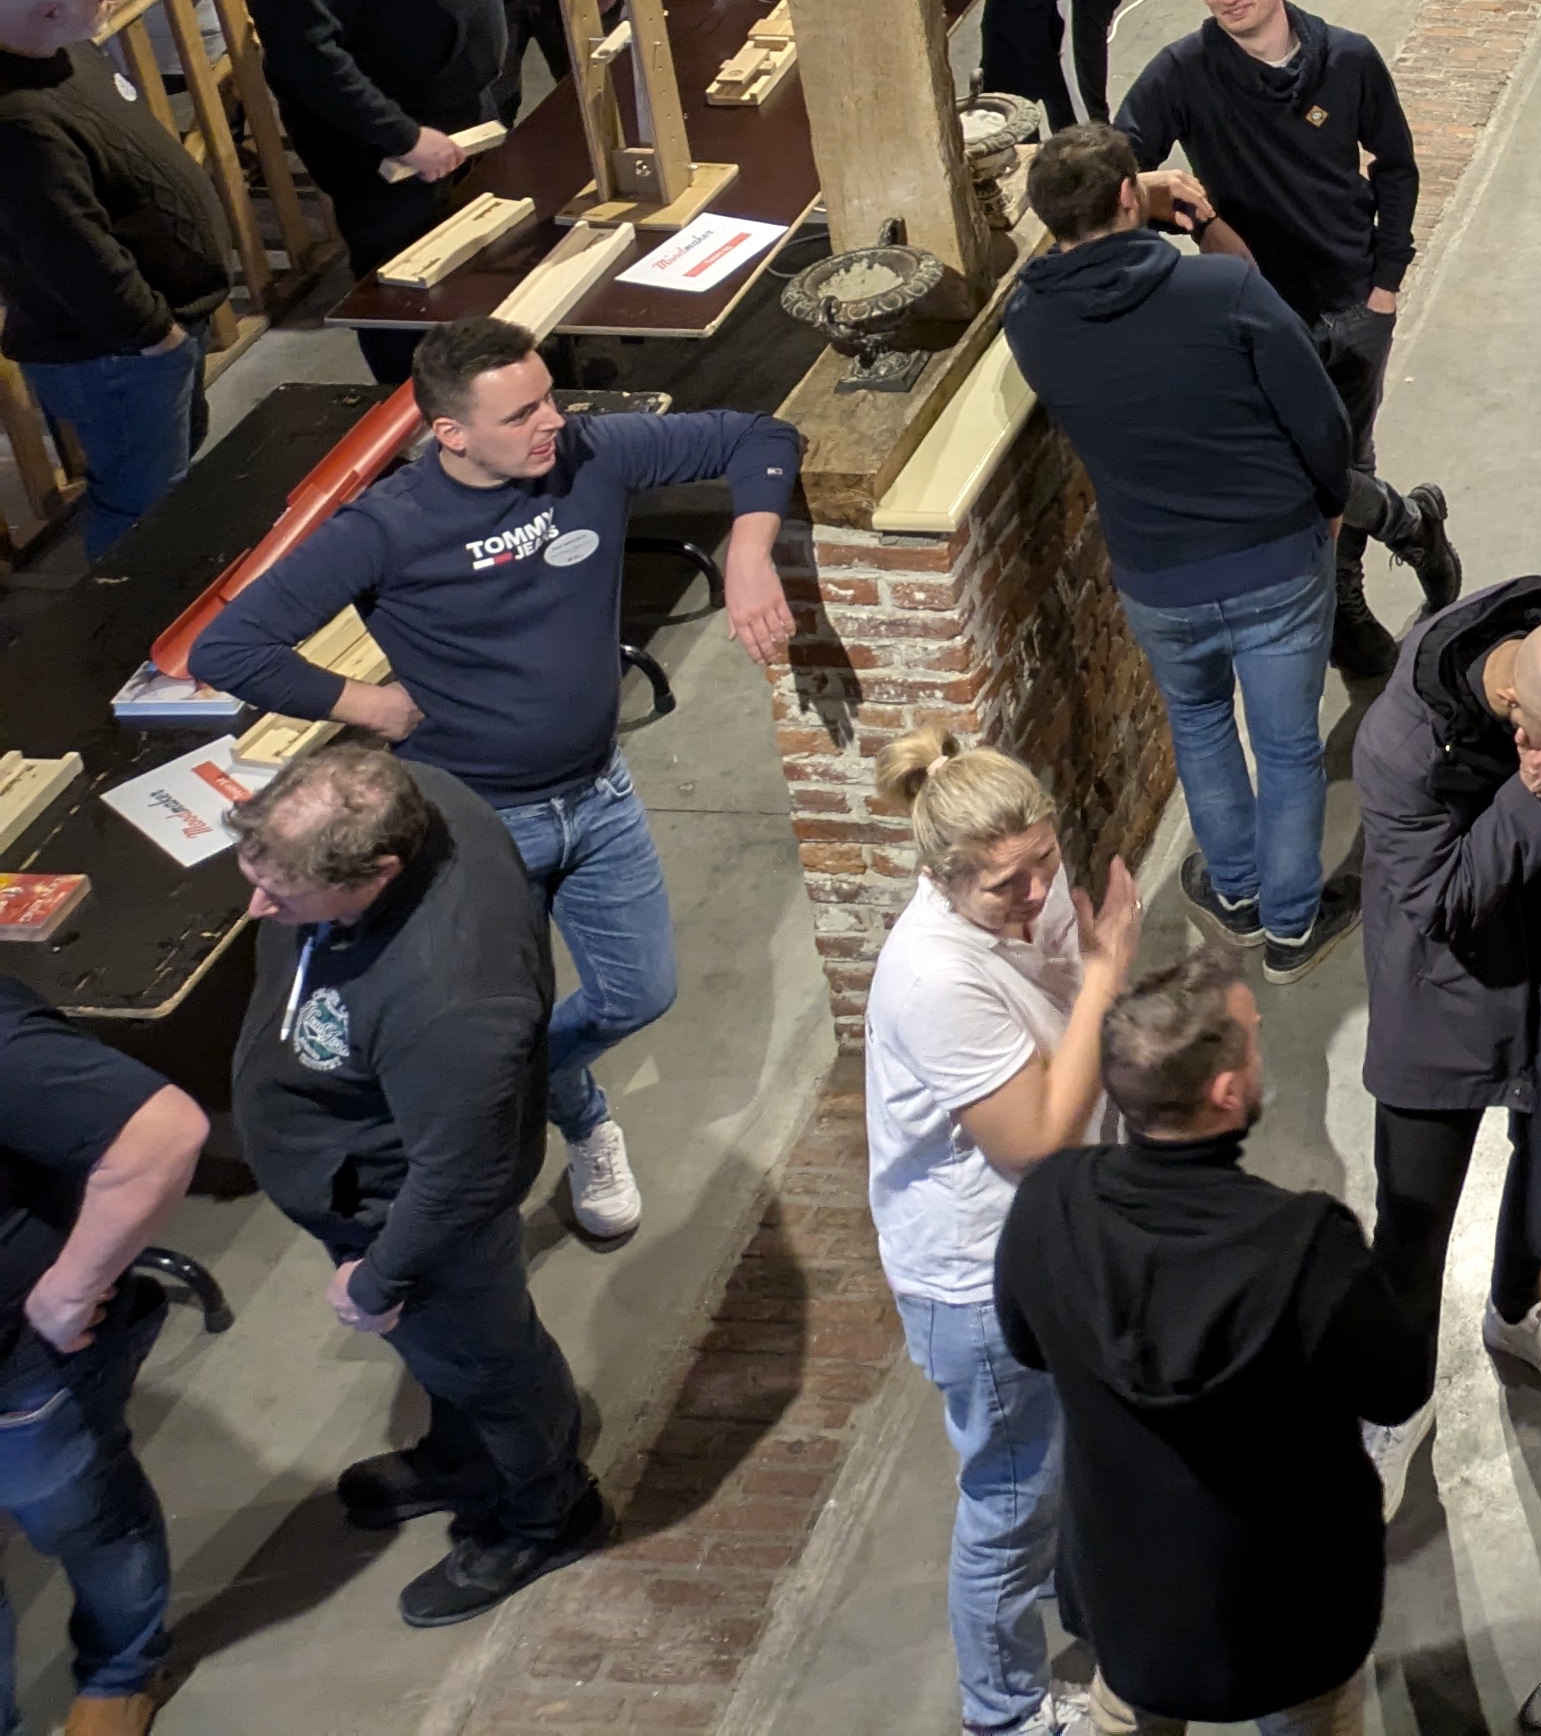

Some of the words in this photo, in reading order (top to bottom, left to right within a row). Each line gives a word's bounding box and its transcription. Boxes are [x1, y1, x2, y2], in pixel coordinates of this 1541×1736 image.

[652, 229, 715, 271] Moodmaker
[466, 507, 554, 559] TOMMY
[147, 789, 213, 839] Moodmaker
